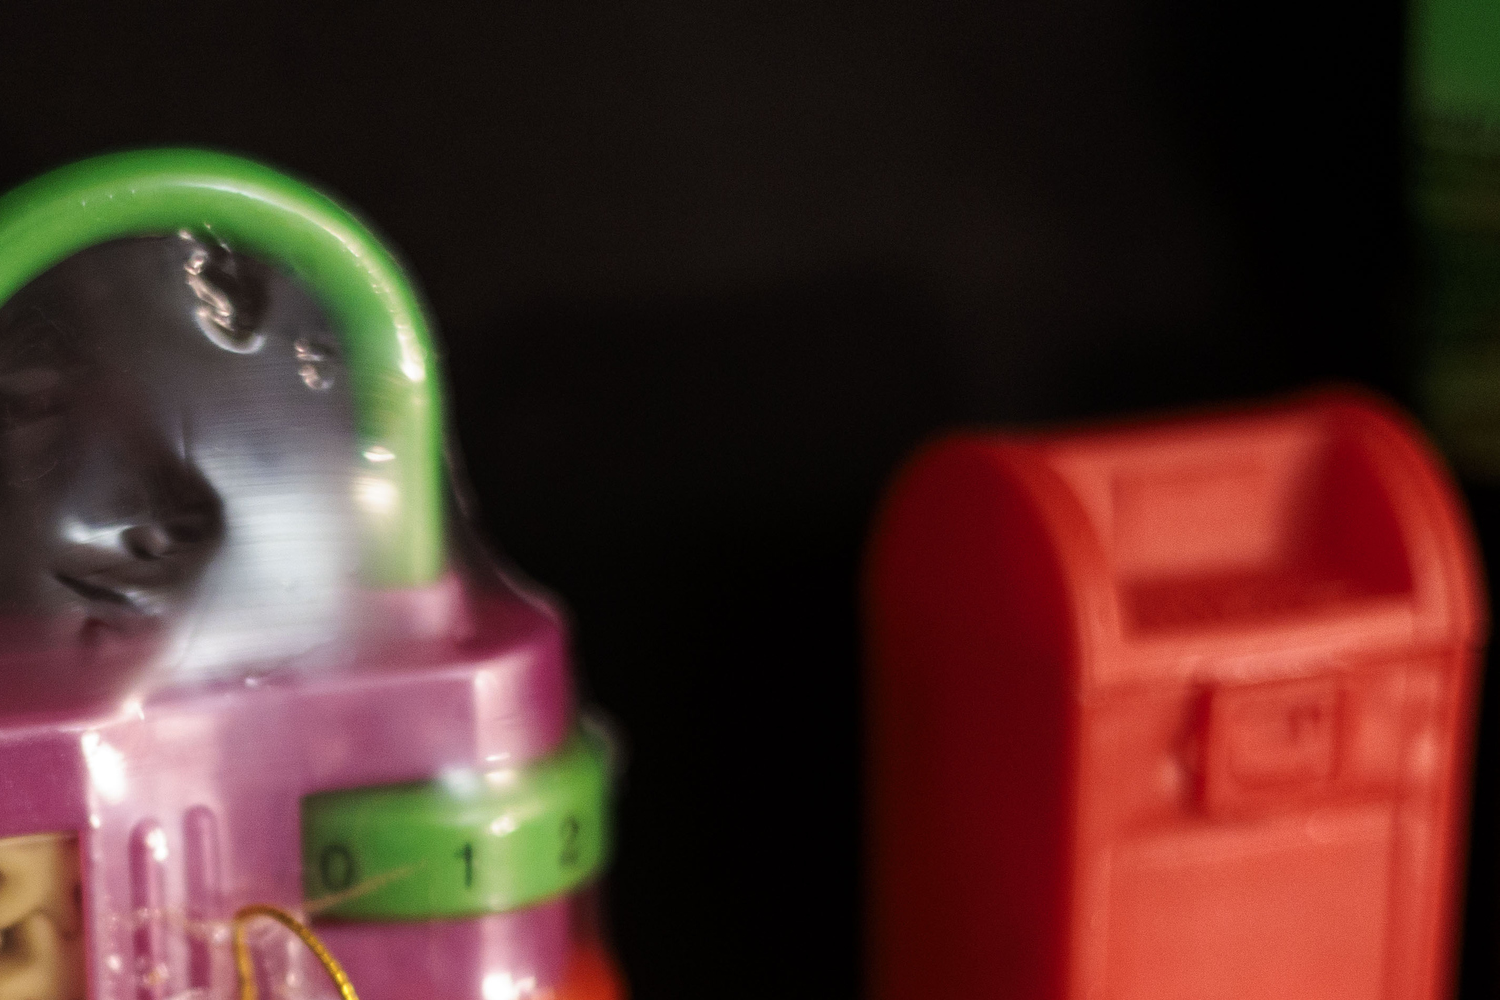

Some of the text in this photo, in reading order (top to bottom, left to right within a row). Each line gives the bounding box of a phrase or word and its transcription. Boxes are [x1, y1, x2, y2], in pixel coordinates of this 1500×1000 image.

[319, 813, 582, 891] 0 1 2
